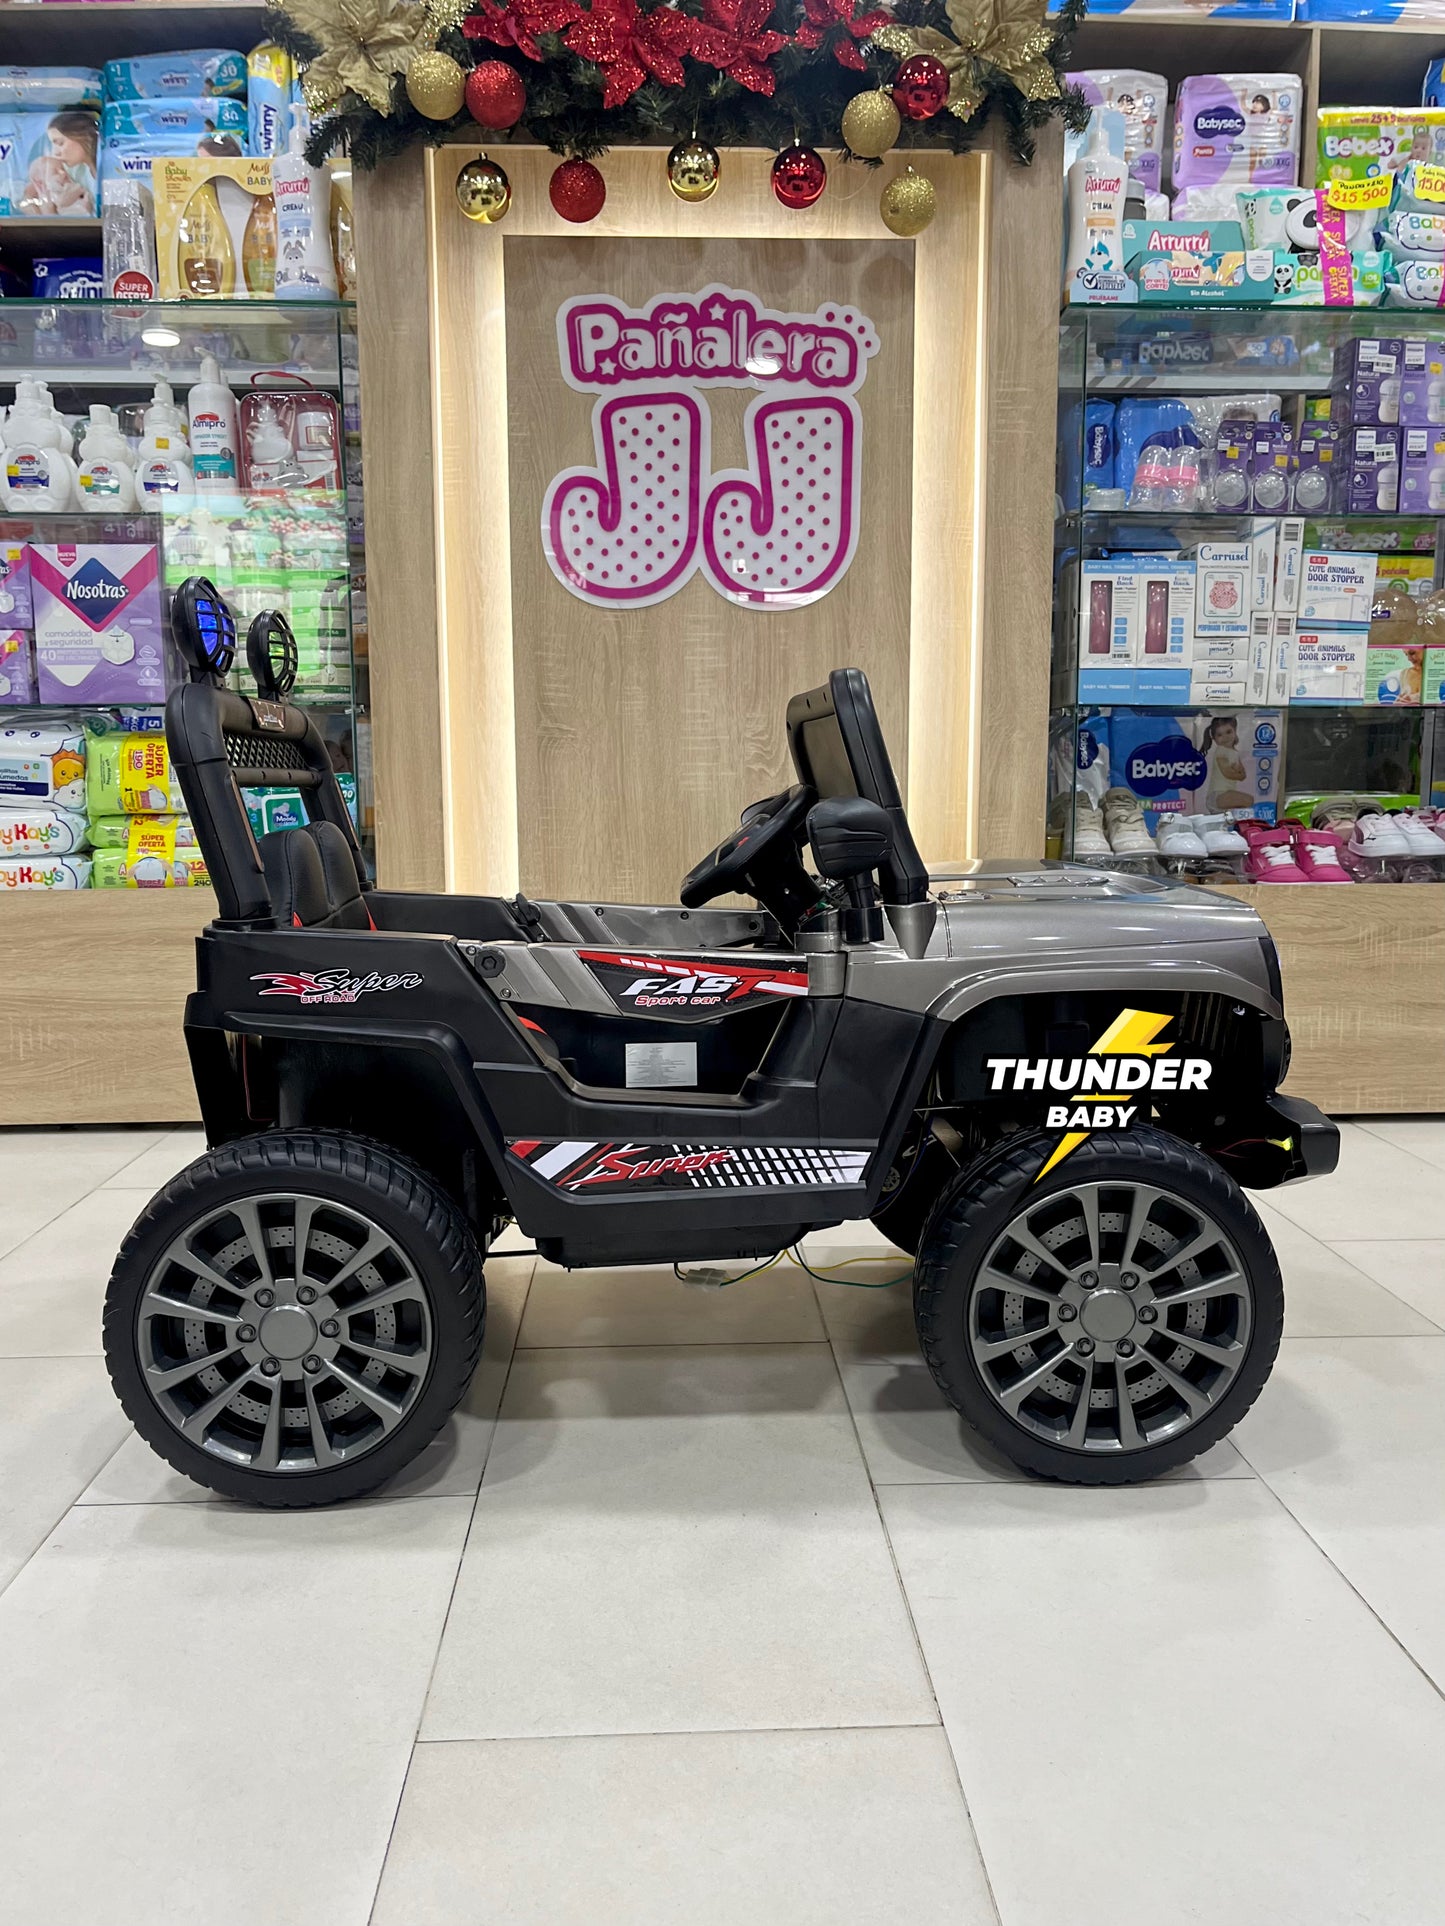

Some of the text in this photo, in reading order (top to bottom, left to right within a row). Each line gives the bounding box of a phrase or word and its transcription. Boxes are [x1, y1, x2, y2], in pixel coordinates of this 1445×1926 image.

[162, 73, 189, 86] winny
[161, 113, 188, 125] winny
[1197, 117, 1243, 131] Babysec
[260, 104, 277, 151] winny
[1324, 135, 1394, 159] Bebex
[1275, 157, 1290, 168] XXG
[247, 177, 273, 186] BABY
[118, 281, 149, 292] SUPER
[570, 297, 856, 384] Pañalera
[192, 418, 226, 430] Almipro
[550, 391, 853, 600] JJ
[1200, 545, 1250, 561] Carrusel
[1287, 547, 1298, 577] Carrusel
[1308, 565, 1356, 574] CUTE ANIMALS
[1307, 573, 1365, 584] DOOR STOPPER
[67, 579, 127, 599] Nosotras
[1256, 577, 1266, 605] Carrusel
[44, 630, 92, 638] comodidad
[49, 638, 94, 647] seguridad
[1317, 644, 1346, 652] ANIMALS
[40, 650, 56, 661] 40
[1208, 646, 1235, 656] Carrusel
[1257, 641, 1267, 670] Carrusel
[1279, 641, 1290, 670] Carrusel
[1298, 652, 1356, 661] DOOR STOPPER
[1207, 669, 1234, 679] Carrusel
[1079, 731, 1090, 767] Babysec
[134, 748, 144, 770] 190
[145, 742, 156, 779] OFERTA
[155, 744, 165, 777] SÚPER
[1132, 758, 1201, 780] Babysec
[1152, 801, 1186, 810] PROTECT
[14, 823, 60, 843] Kay's
[141, 833, 165, 841] SÚPER
[20, 866, 65, 887] Kay's
[193, 879, 211, 887] 240
[302, 968, 424, 1001] Super
[620, 975, 776, 1001] FAST
[301, 994, 356, 1004] OFF ROAD
[634, 995, 722, 1008] Sport car
